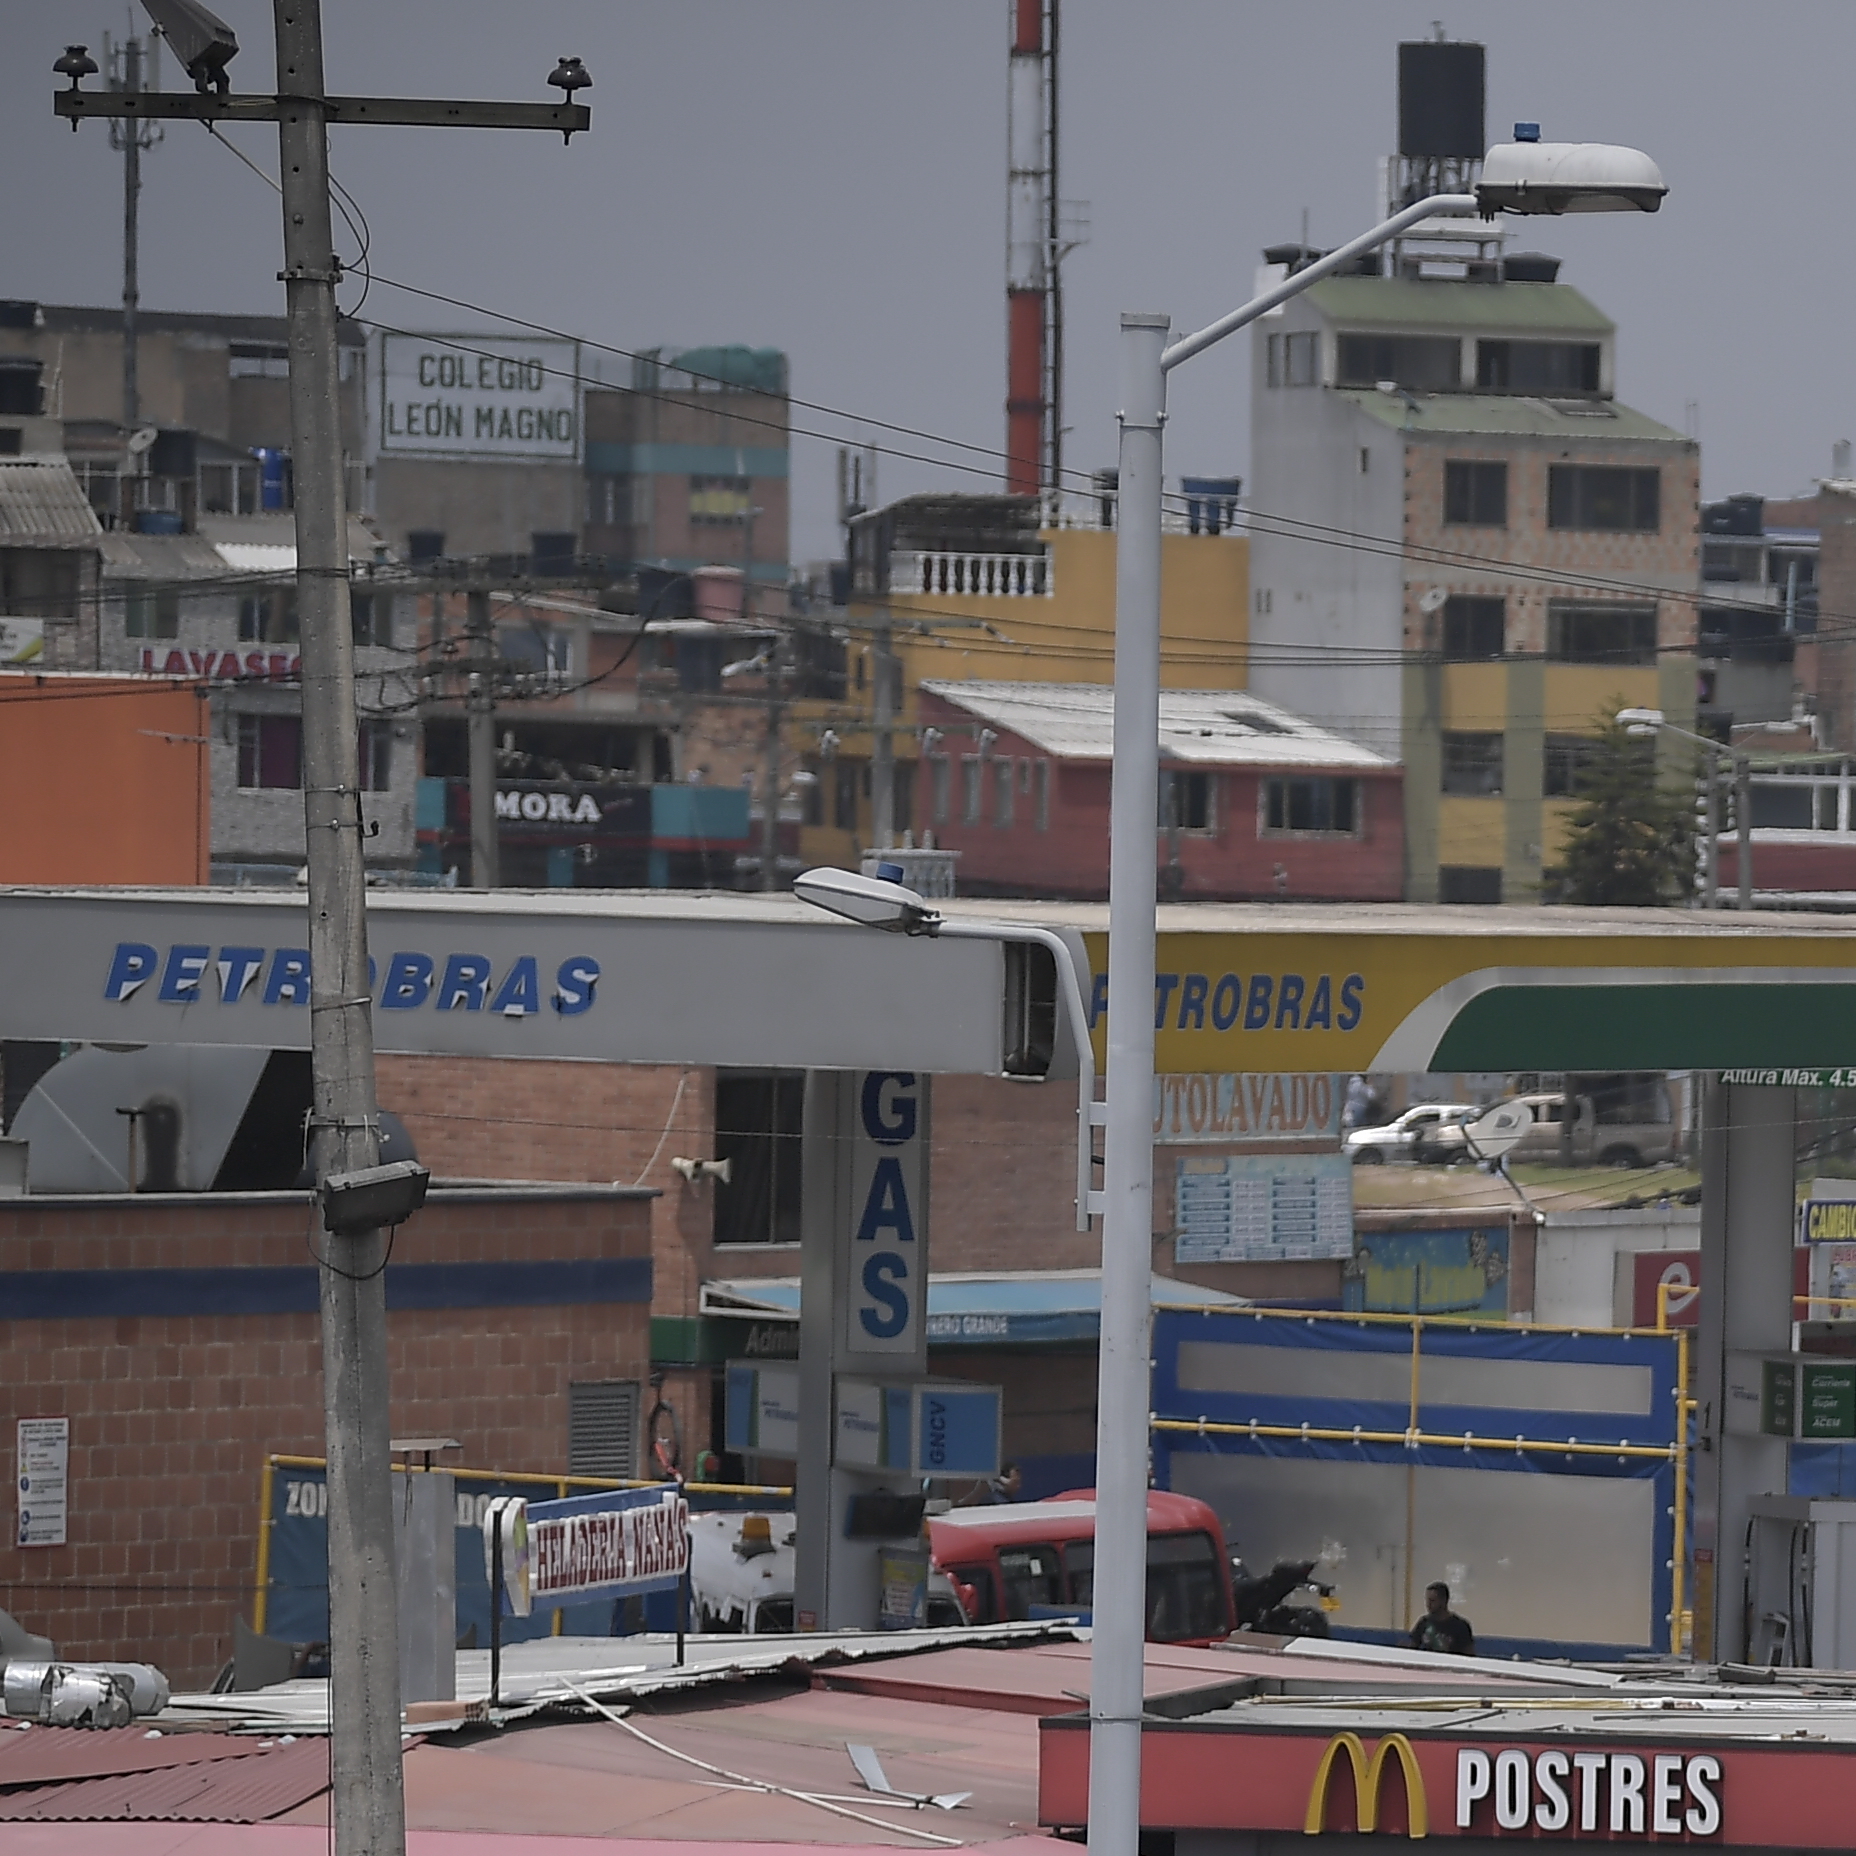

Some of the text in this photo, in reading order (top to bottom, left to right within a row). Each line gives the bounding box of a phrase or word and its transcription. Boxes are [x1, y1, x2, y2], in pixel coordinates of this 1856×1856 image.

[419, 353, 543, 392] COLEGIO
[387, 397, 571, 441] LEÓN MAGNO
[494, 790, 602, 822] MORA
[104, 941, 602, 1018] PETRBRAS
[1089, 972, 1365, 1031] PTROBRAS
[1722, 1069, 1778, 1085] Altura
[1781, 1070, 1822, 1087] Max.
[857, 1070, 916, 1339] GAS
[930, 1399, 947, 1465] GNCV
[536, 1512, 625, 1592] HELADERIA
[1456, 1747, 1722, 1837] POSTRES
